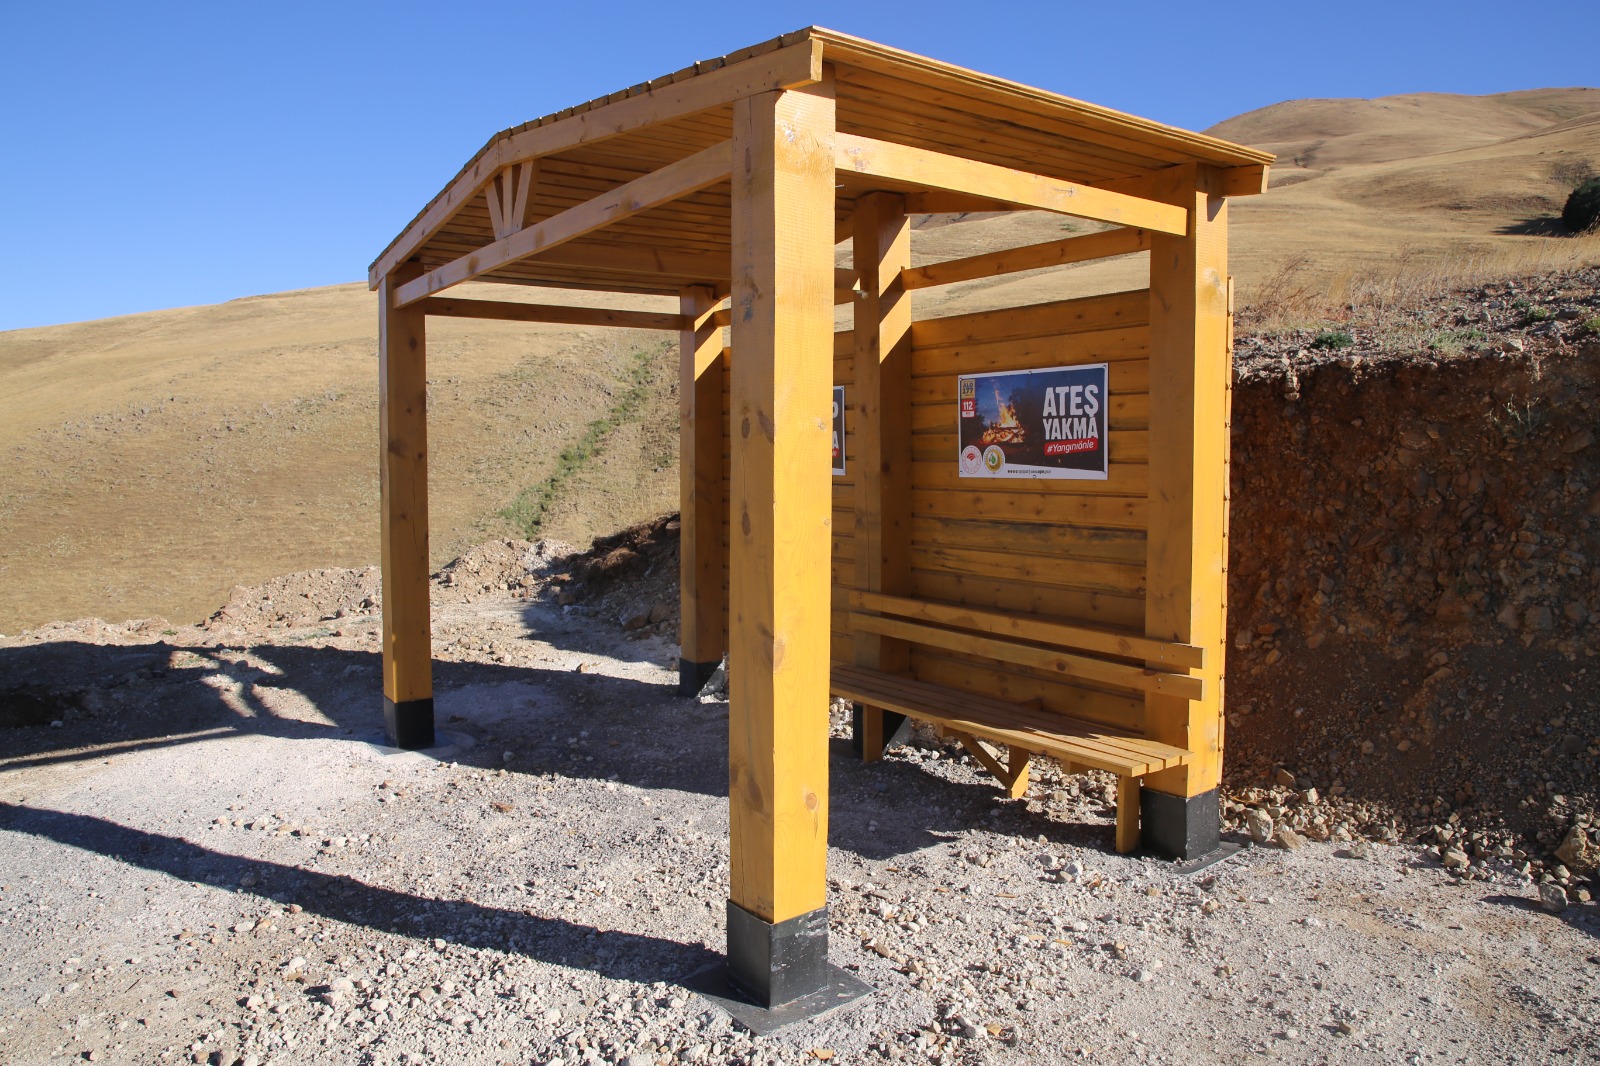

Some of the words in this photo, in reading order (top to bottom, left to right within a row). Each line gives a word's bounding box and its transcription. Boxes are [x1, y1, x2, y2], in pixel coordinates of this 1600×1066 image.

[963, 401, 974, 411] 112
[1042, 384, 1099, 417] ATEŞ
[1042, 417, 1099, 440] YAKMA
